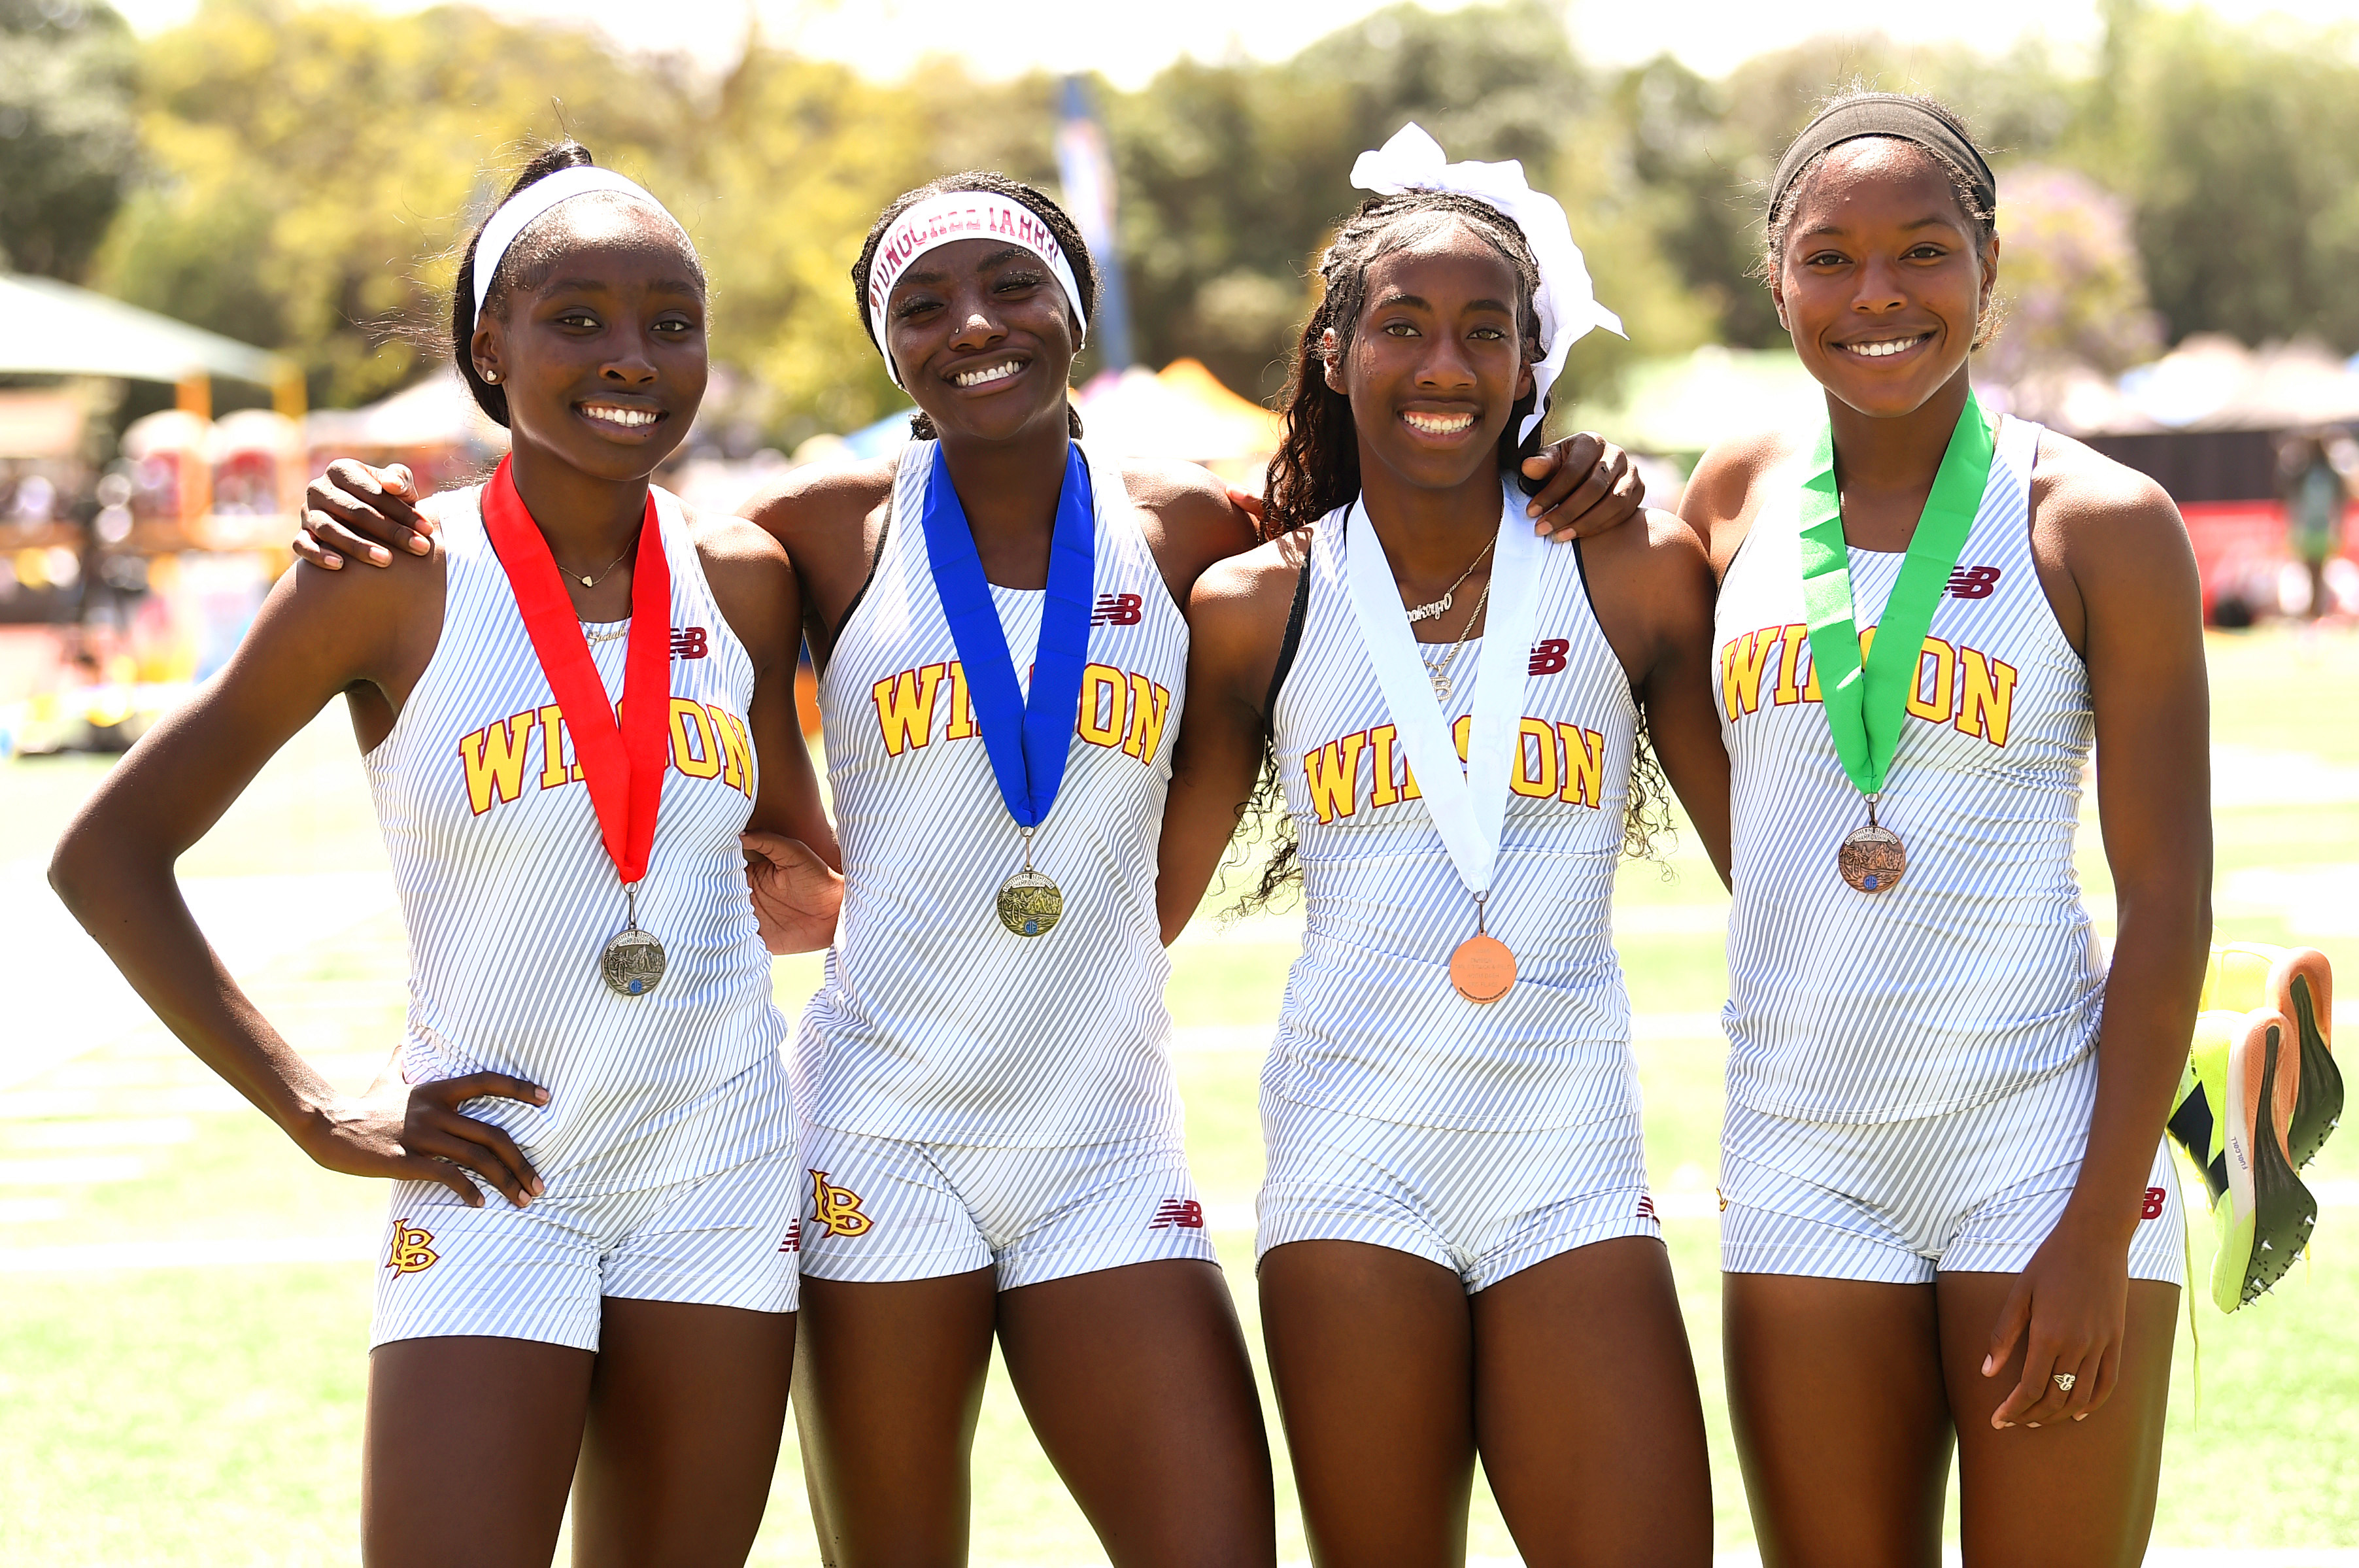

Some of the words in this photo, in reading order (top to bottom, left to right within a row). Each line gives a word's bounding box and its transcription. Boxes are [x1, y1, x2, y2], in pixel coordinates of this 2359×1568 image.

[1721, 623, 2017, 749] WION
[872, 660, 1170, 767] WION
[458, 696, 755, 817] WION
[1844, 828, 1873, 845] SOUTHERN
[1875, 828, 1898, 844] SECTION
[1002, 874, 1030, 892] SOUTHERN
[1032, 874, 1055, 889] SECTION
[1863, 876, 1877, 889] CIF
[1025, 921, 1038, 934] CIF
[637, 931, 658, 947] SECTION
[629, 980, 643, 993] CIF
